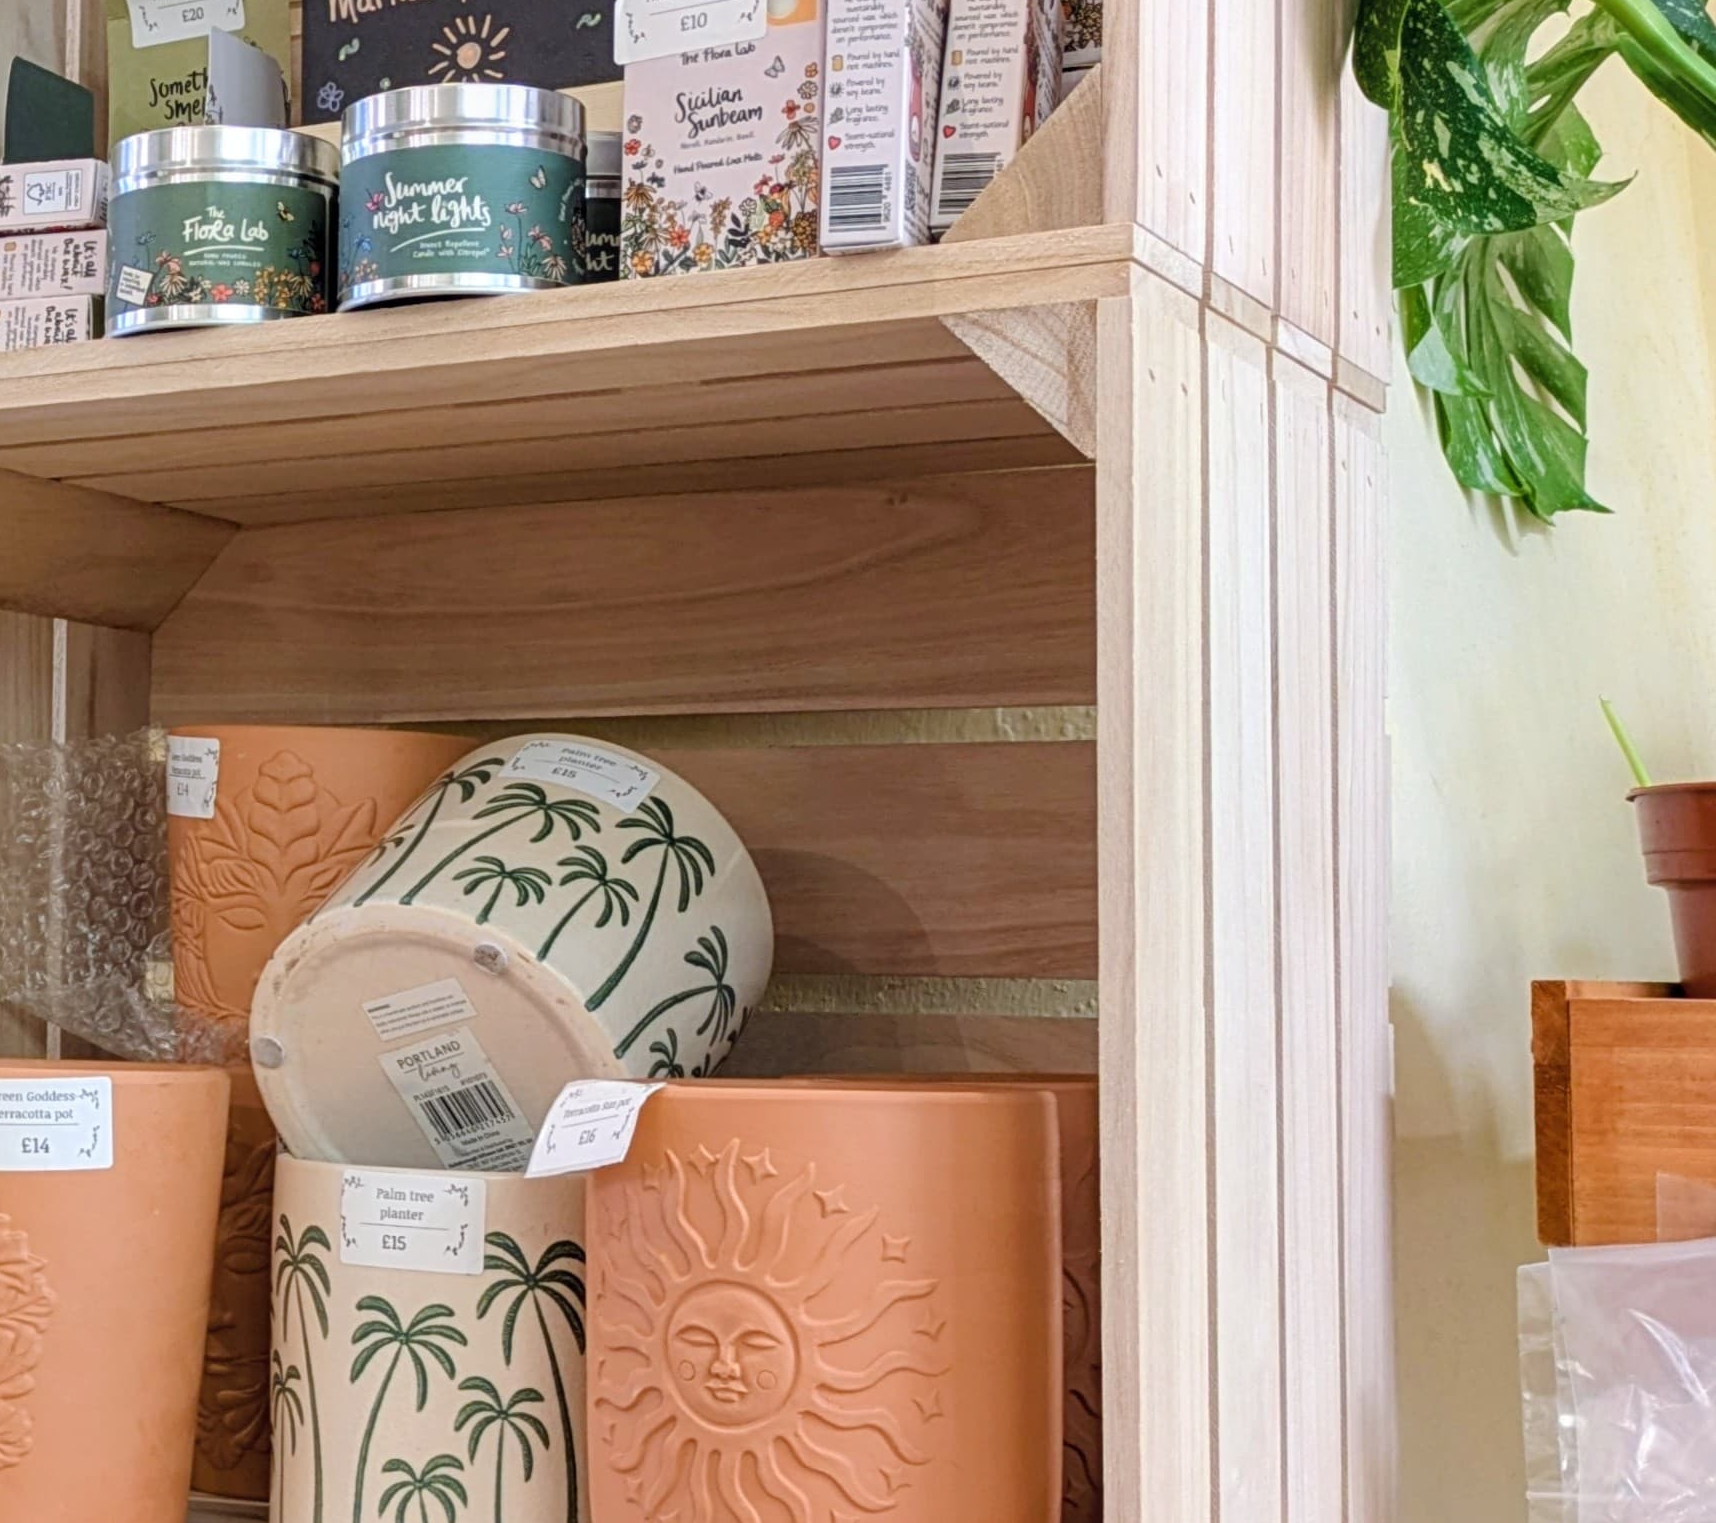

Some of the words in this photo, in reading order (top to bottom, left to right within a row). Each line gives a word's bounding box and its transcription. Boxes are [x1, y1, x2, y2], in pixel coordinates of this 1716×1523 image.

[182, 6, 204, 23] £20
[680, 12, 708, 31] £10
[704, 46, 732, 63] Flora
[734, 42, 756, 56] Lab
[674, 87, 743, 124] Sicilian
[687, 105, 763, 139] Sunbeam
[384, 172, 468, 209] Summer
[206, 205, 225, 219] The
[373, 203, 426, 234] night
[431, 194, 492, 230] lights
[240, 218, 269, 242] Lab
[558, 755, 603, 771] planter
[561, 747, 592, 760] Palm
[593, 753, 618, 767] tree
[551, 766, 577, 779] £15
[397, 1040, 461, 1071] PORTLAND
[26, 1089, 77, 1102] Goddess
[55, 1108, 74, 1122] pot
[21, 1136, 50, 1154] £14
[578, 1128, 597, 1146] £16
[376, 1187, 407, 1203] Palm
[409, 1189, 435, 1204] tree
[379, 1206, 425, 1222] planter
[381, 1234, 407, 1252] £15
